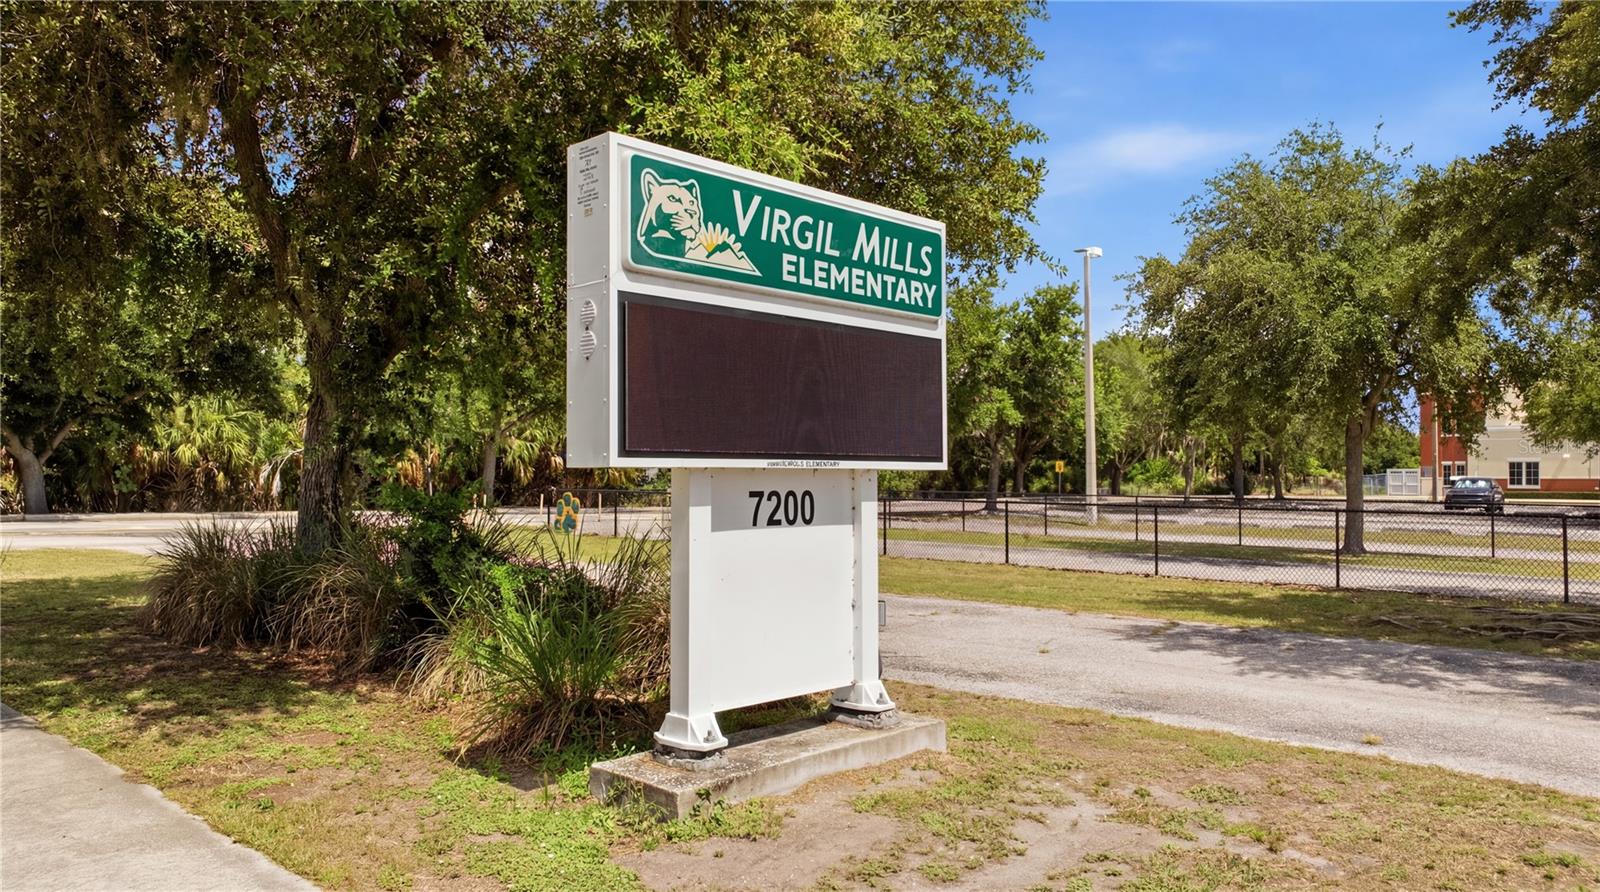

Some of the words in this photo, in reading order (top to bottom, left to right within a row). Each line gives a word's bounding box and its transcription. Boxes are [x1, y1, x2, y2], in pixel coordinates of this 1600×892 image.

[732, 189, 840, 257] VIRGIL
[851, 222, 933, 277] MILLS
[782, 253, 937, 308] ELEMENTARY
[805, 460, 840, 468] ELEMENTARY
[748, 490, 815, 527] 7200
